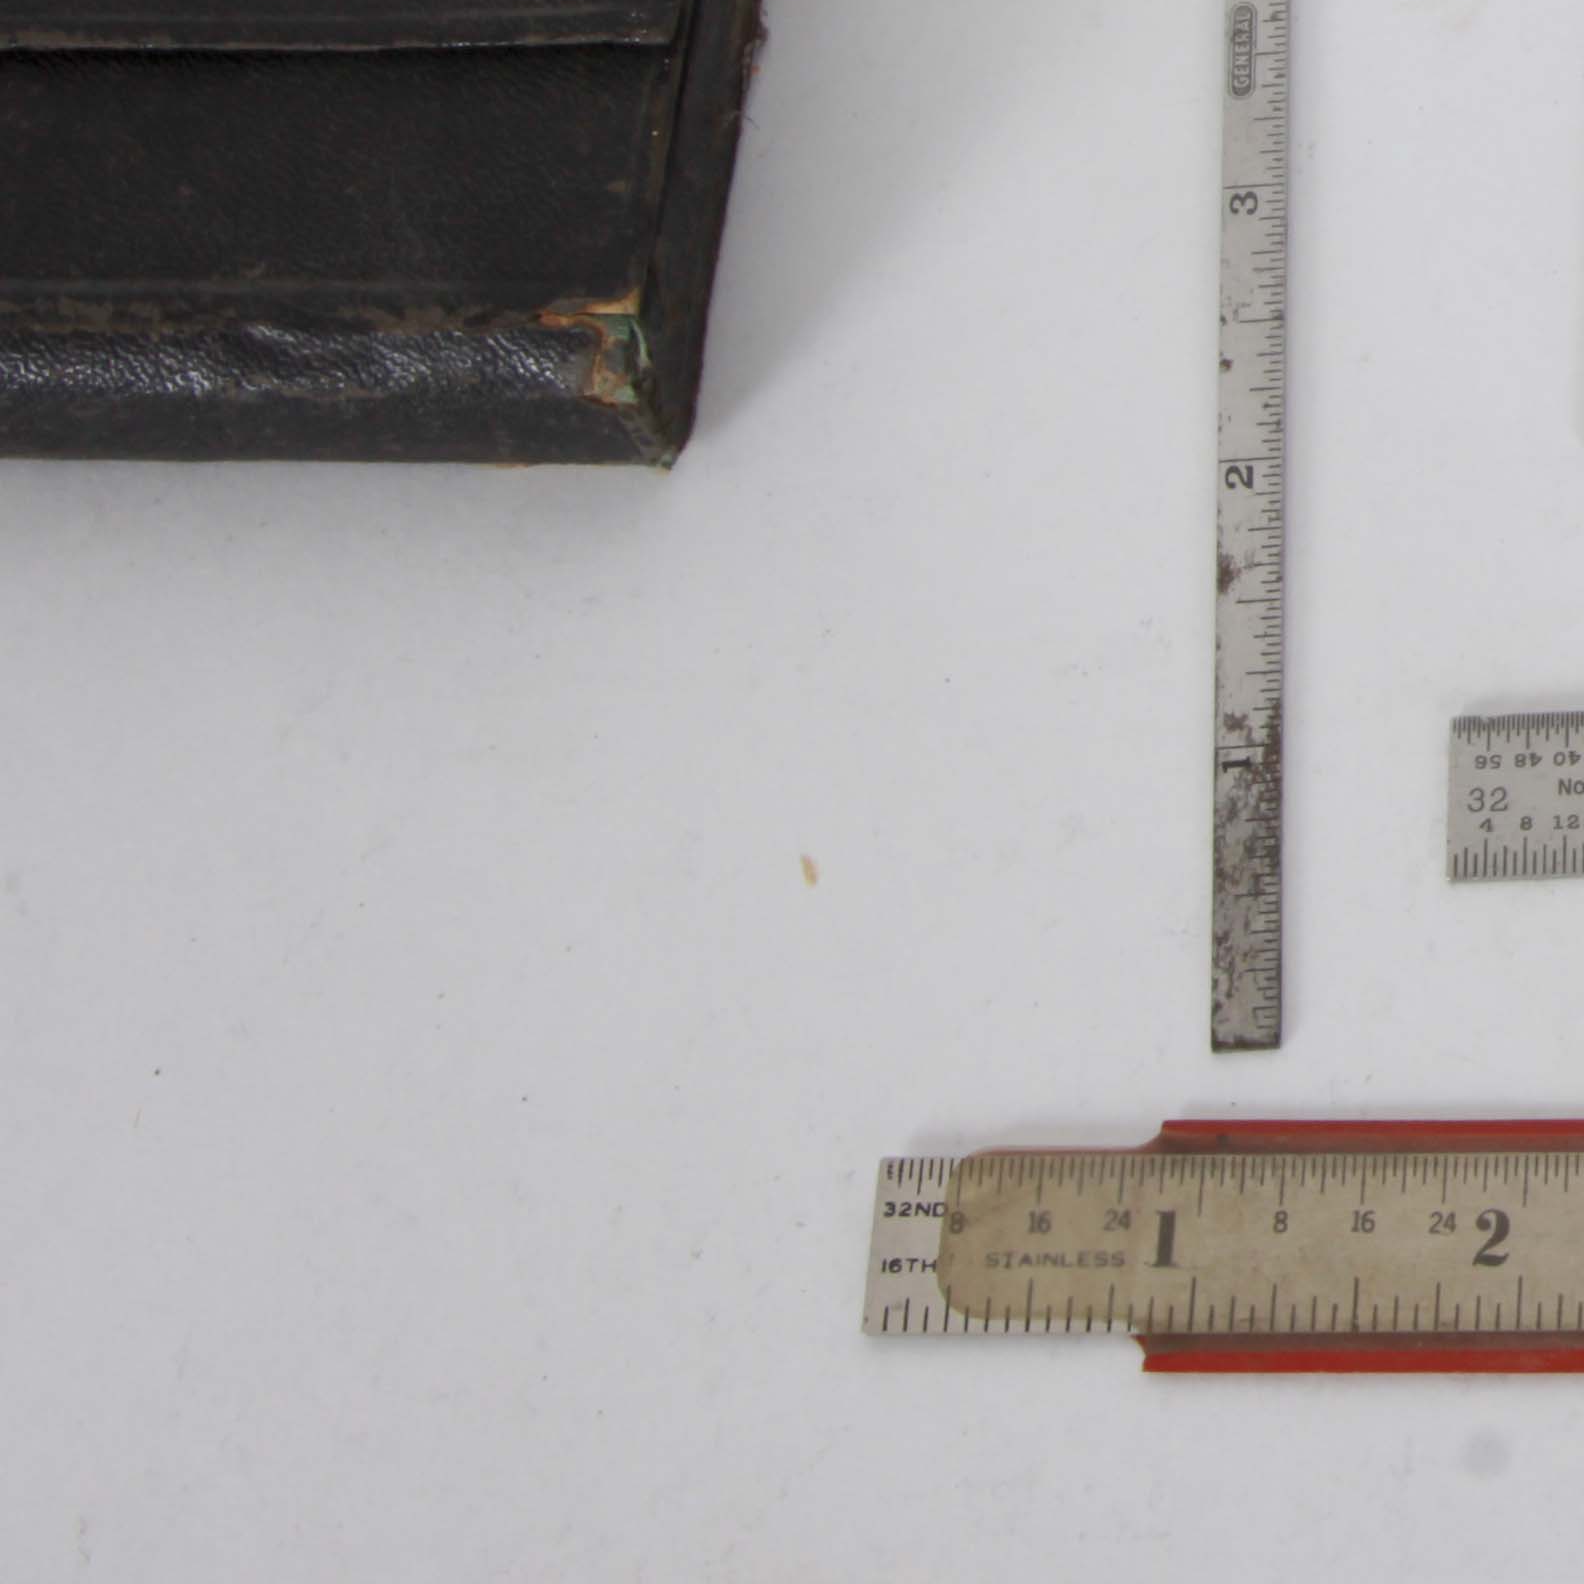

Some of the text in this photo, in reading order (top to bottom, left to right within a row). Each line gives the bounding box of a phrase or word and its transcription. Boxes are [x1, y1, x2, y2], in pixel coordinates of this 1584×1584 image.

[1229, 191, 1258, 215] 3
[1225, 465, 1254, 489] 2
[1467, 786, 1508, 813] 32
[1479, 818, 1493, 833] 4
[1520, 816, 1533, 831] 8
[1553, 814, 1580, 830] 12
[884, 1201, 947, 1219] 32ND
[949, 1211, 967, 1234] 8
[1029, 1211, 1051, 1234] 16
[1104, 1209, 1131, 1231] 24
[1144, 1209, 1181, 1268] 1
[1273, 1210, 1288, 1233] 8
[1351, 1210, 1375, 1234] 16
[1429, 1211, 1456, 1234] 24
[1472, 1209, 1510, 1267] 2
[881, 1258, 938, 1274] 16TH
[984, 1251, 1126, 1269] STAINLESS
